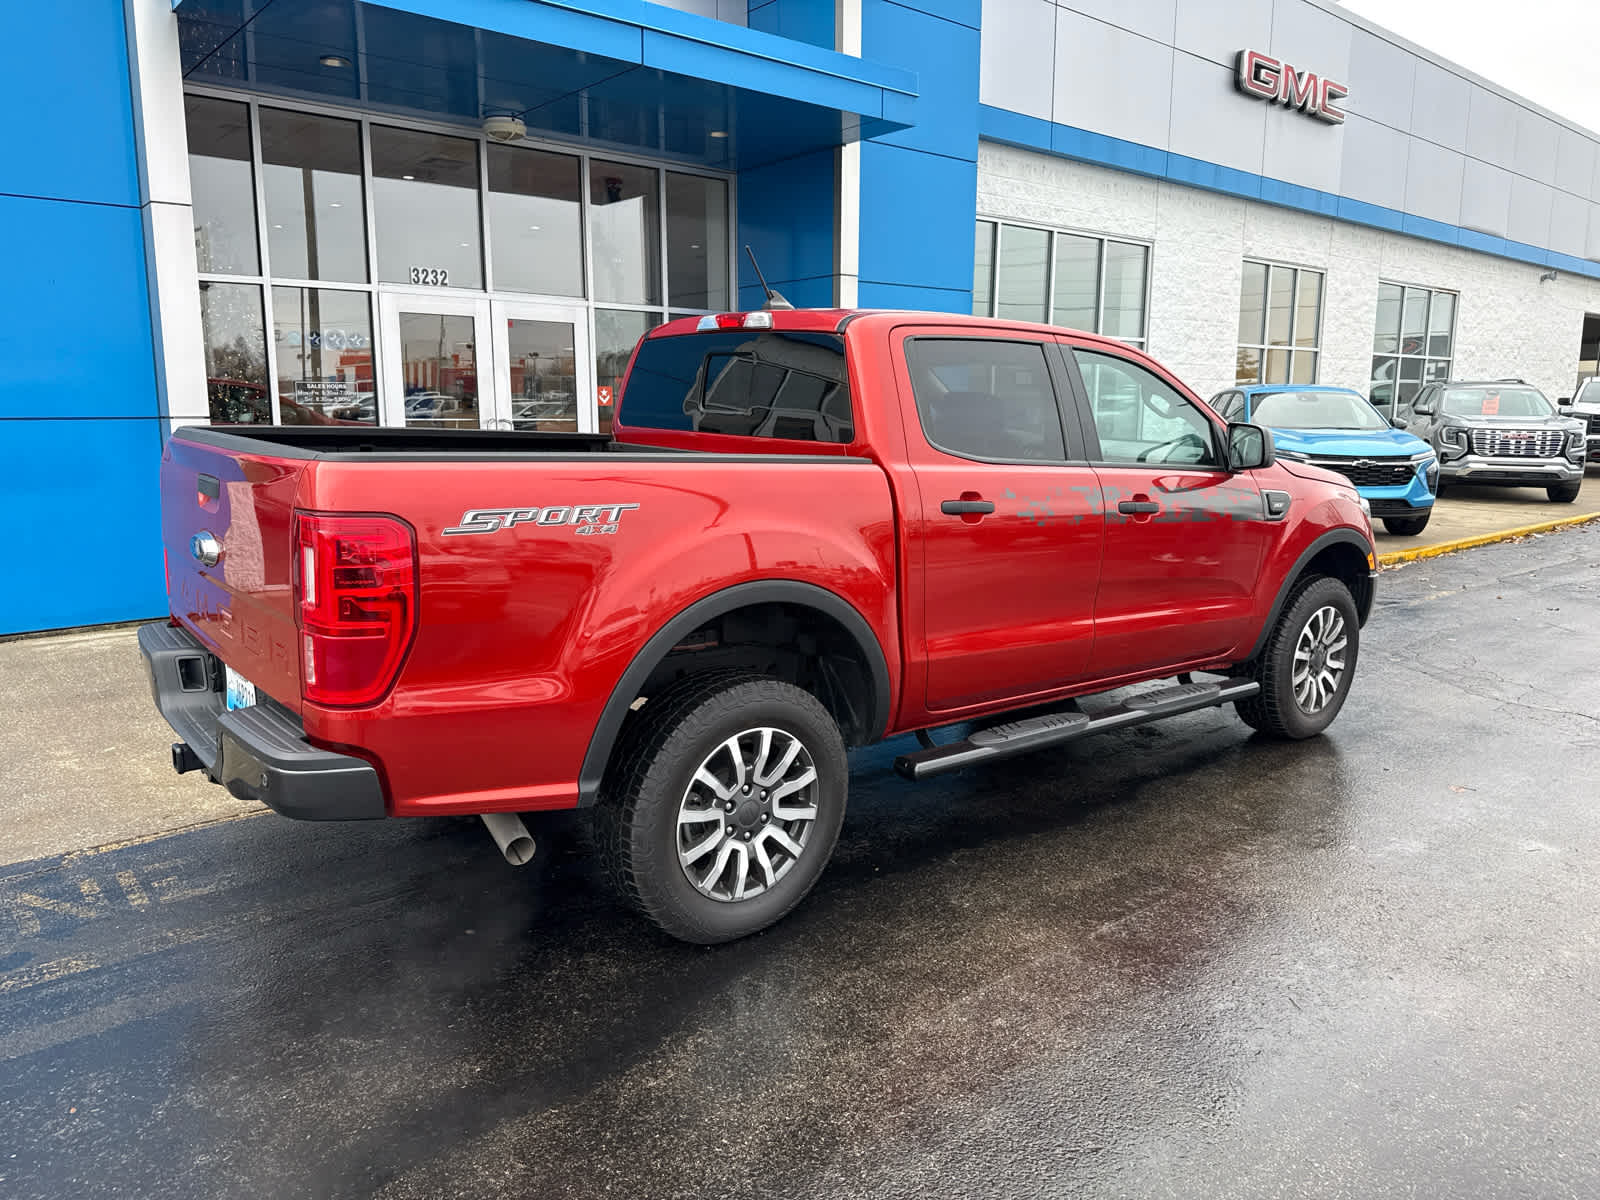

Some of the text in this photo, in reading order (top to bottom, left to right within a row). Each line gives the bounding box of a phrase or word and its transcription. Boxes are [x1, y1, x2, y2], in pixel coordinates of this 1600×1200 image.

[1235, 48, 1350, 125] GMC
[411, 266, 449, 286] 3232
[441, 503, 640, 536] SPORT
